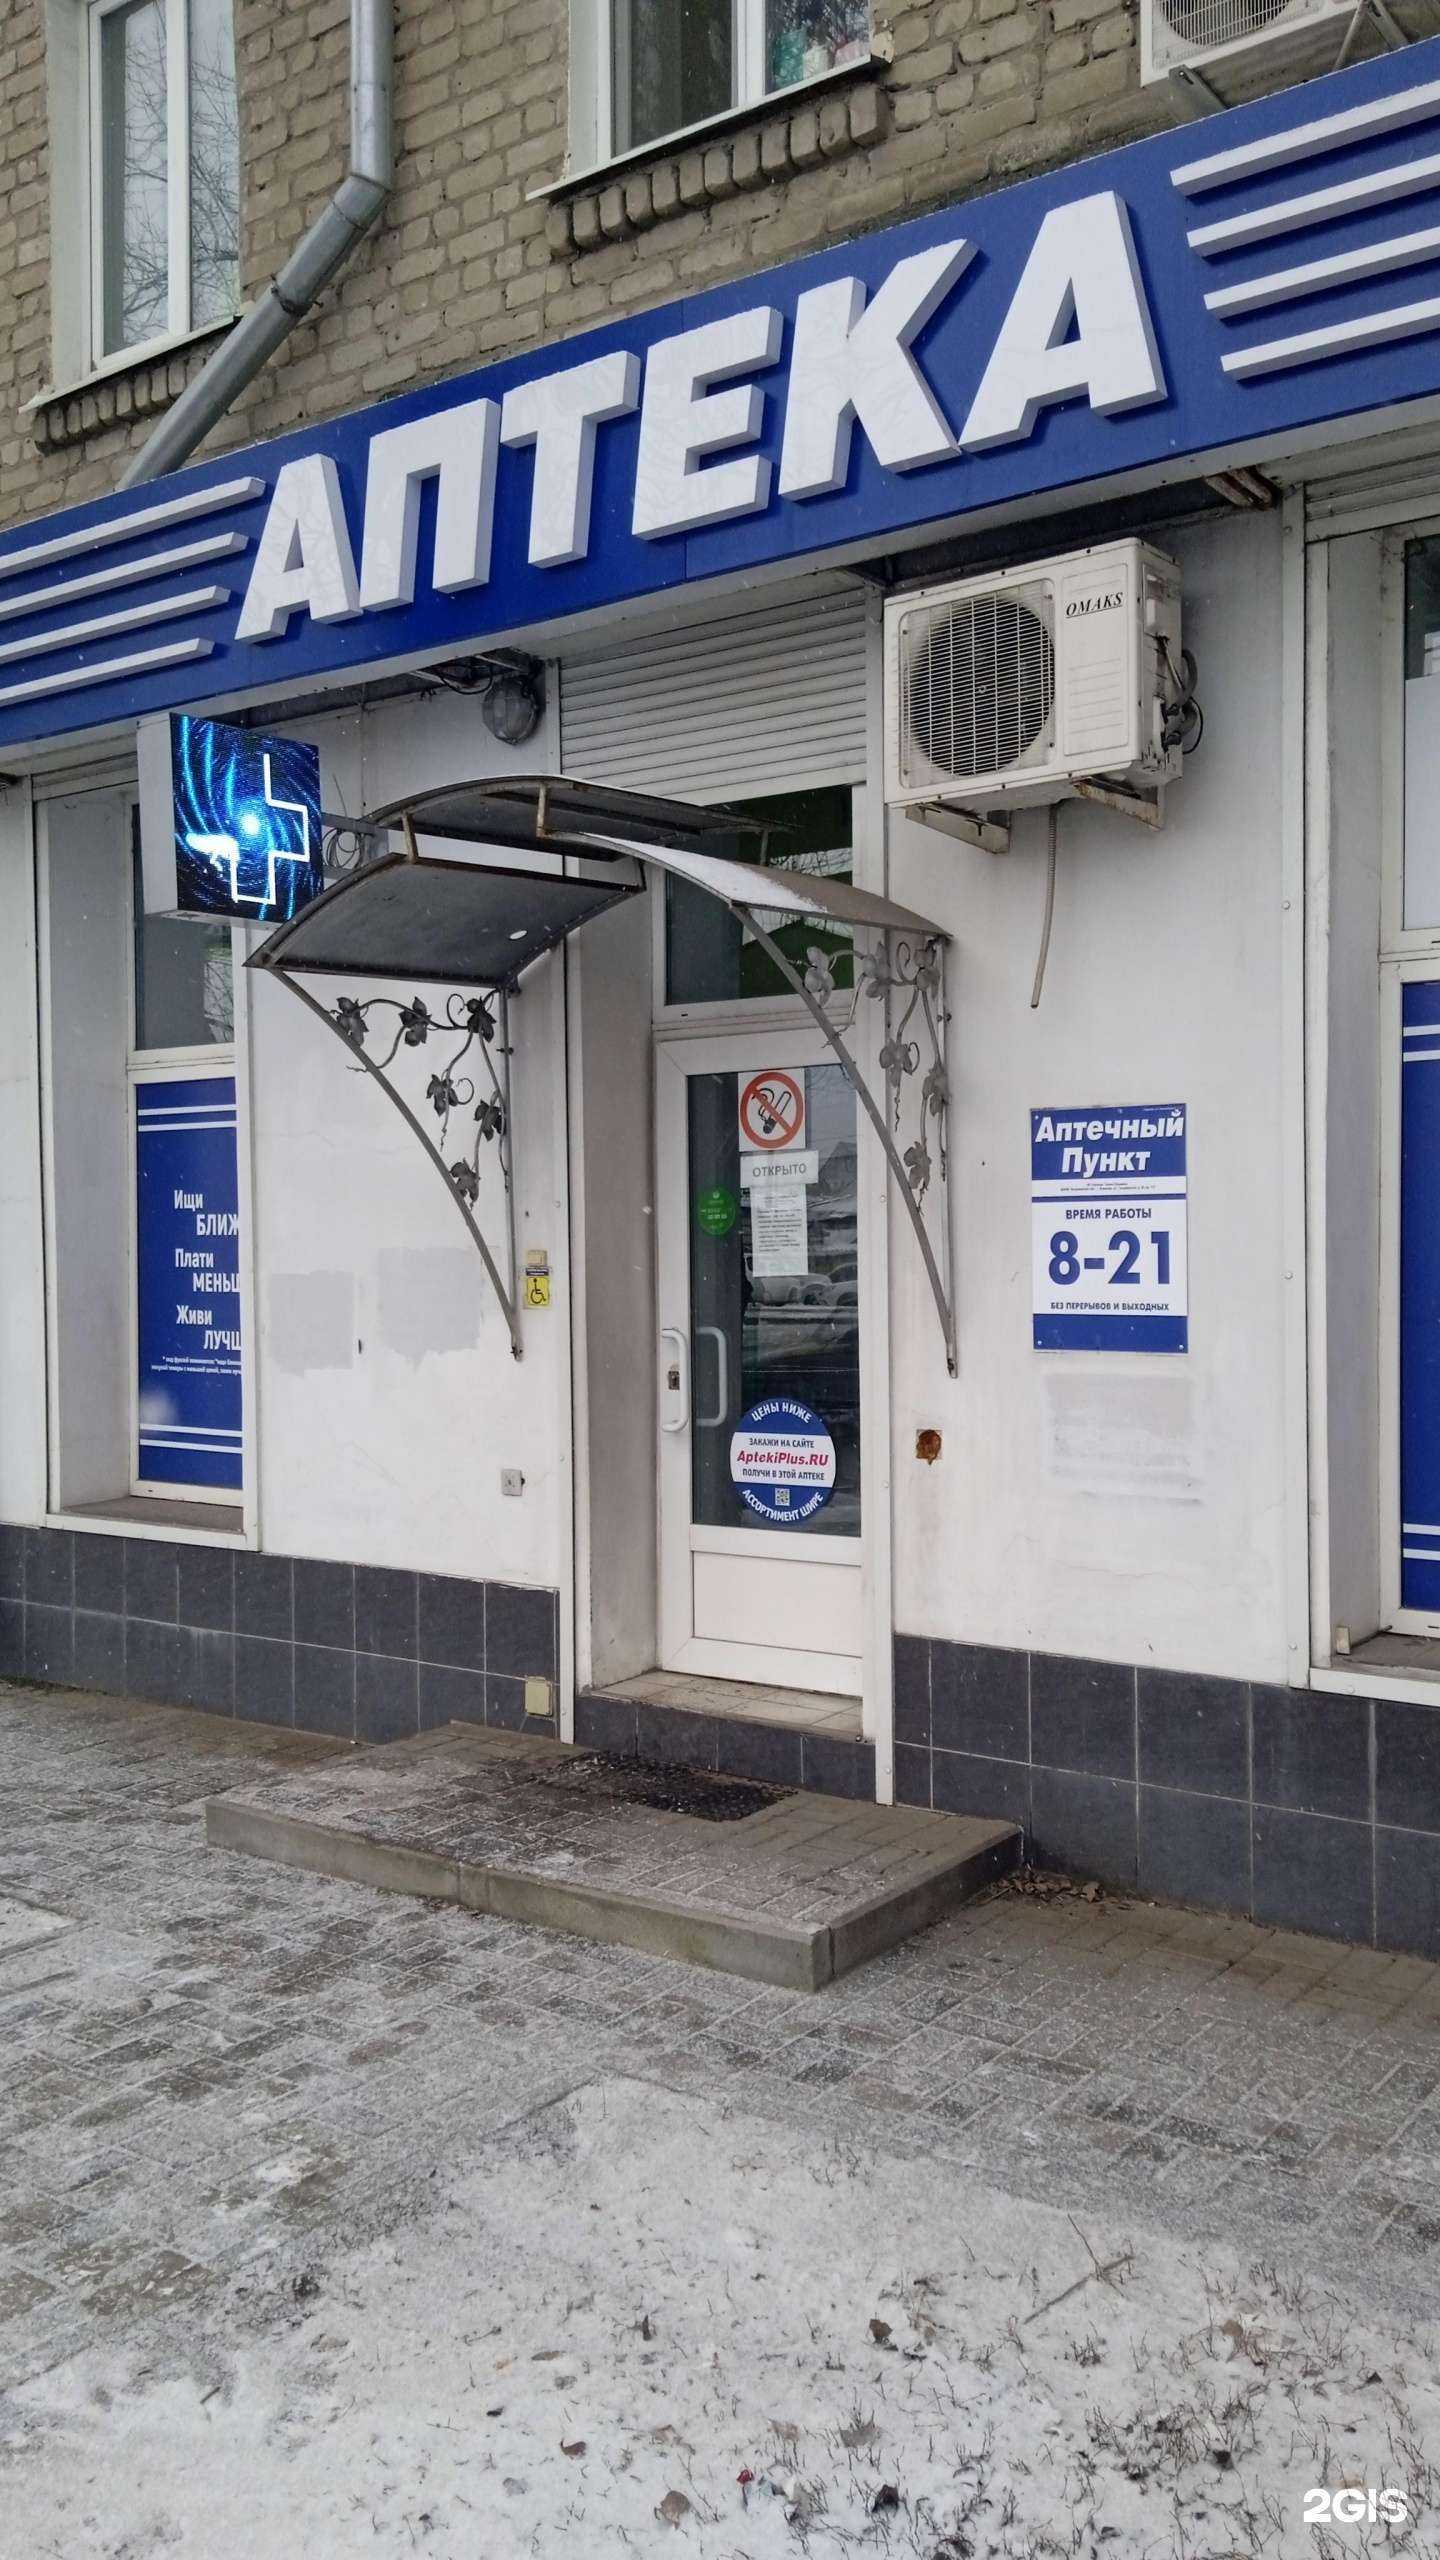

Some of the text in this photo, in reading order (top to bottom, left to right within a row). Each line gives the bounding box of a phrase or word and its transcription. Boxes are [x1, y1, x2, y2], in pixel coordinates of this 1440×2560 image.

[236, 190, 1167, 643] АПТЕКА
[1066, 592, 1123, 617] OMAKS
[1035, 1110, 1184, 1142] Аптечный
[753, 1163, 807, 1177] ОТКРЫТО
[1062, 1147, 1150, 1178] Пункт
[174, 1190, 203, 1211] Ищи
[1065, 1208, 1152, 1220] ВРЕМЯ РАБОТЫ
[175, 1248, 214, 1268] Плати
[1048, 1230, 1170, 1285] 8-21
[176, 1304, 213, 1325] Живи
[1050, 1302, 1064, 1310] БЕЗ
[1066, 1302, 1111, 1310] ПЕРЕРЫВОВ
[1122, 1303, 1169, 1312] ВЫХОДНЫХ
[751, 1402, 812, 1423] ЦЕНЫ НИЖЕ
[749, 1438, 814, 1448] ЗАКАЖИ НА САЙТЕ
[737, 1451, 829, 1466] AptekiPlus.RU
[742, 1468, 825, 1480] ПОЛУЧИ В ЭТОЙ АПТЕКЕ
[742, 1489, 824, 1522] АССОРТИМЕНТ ШИРЕ
